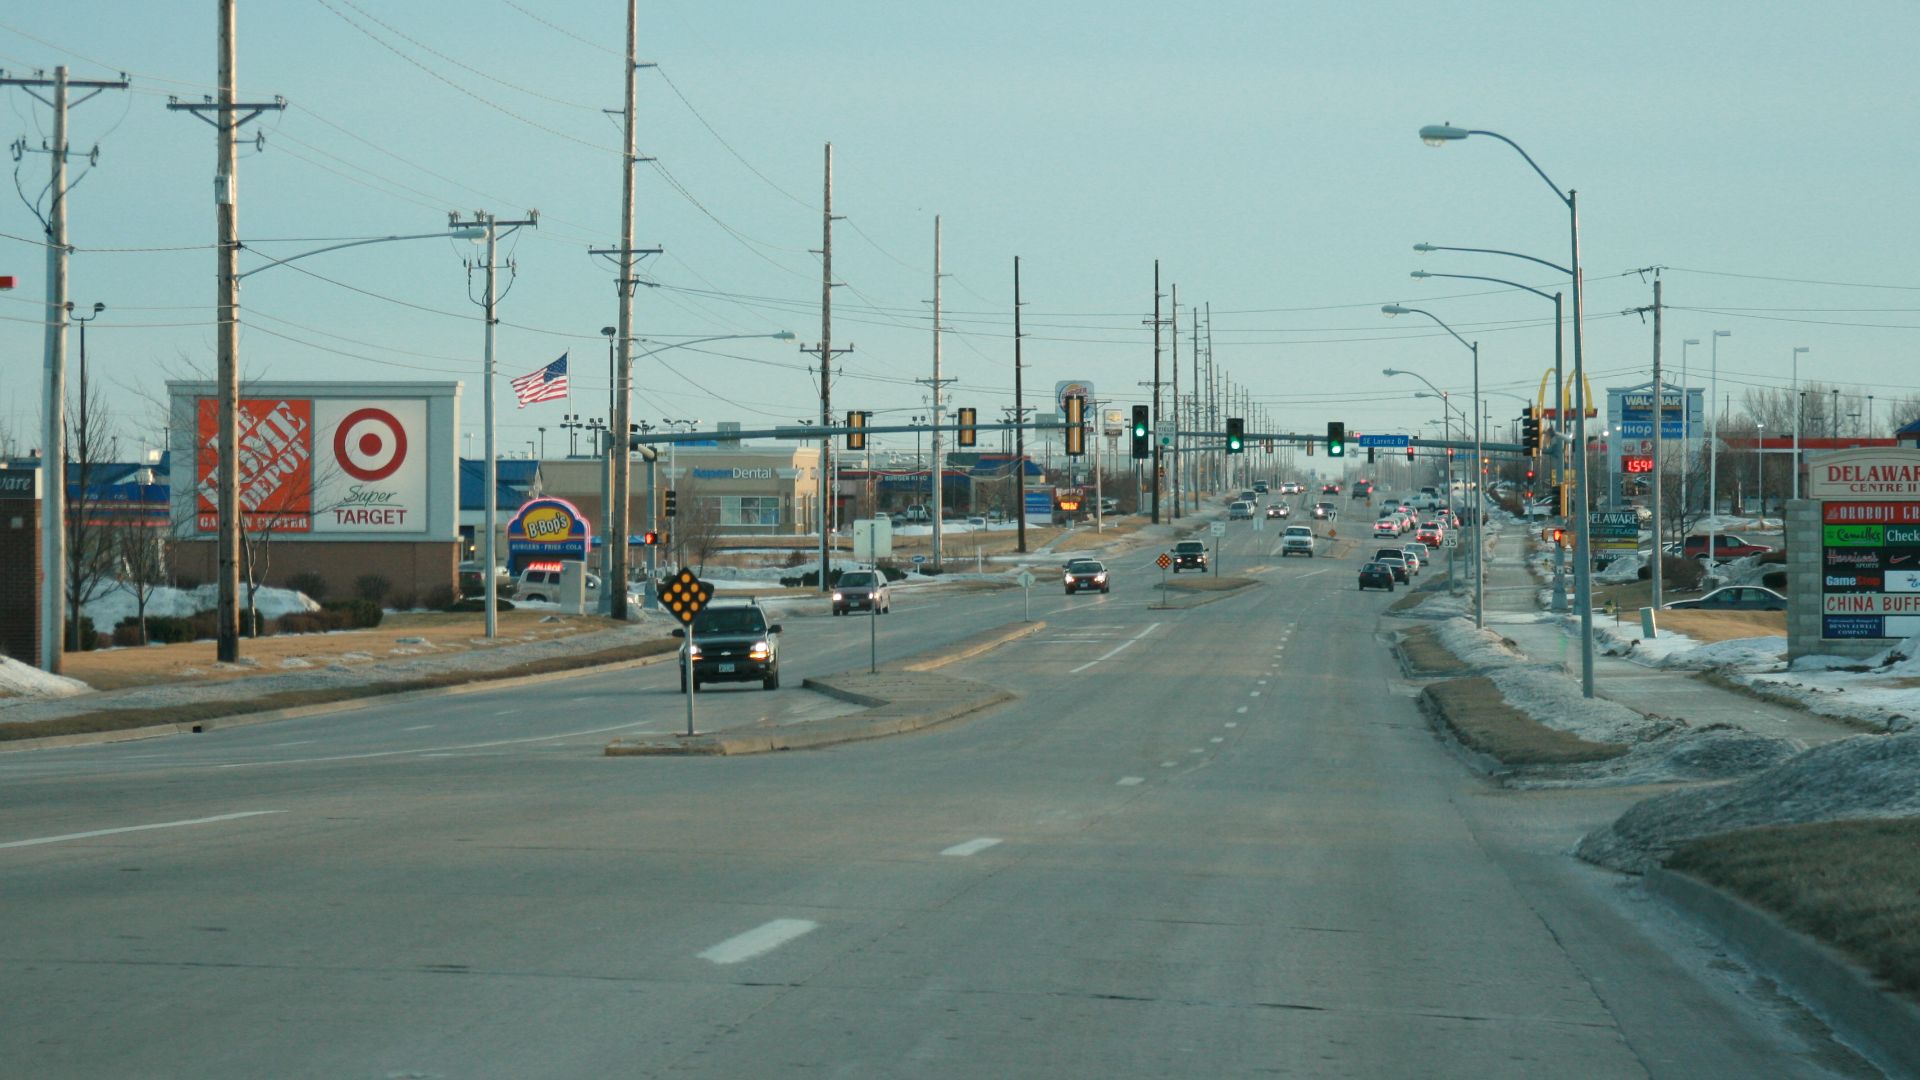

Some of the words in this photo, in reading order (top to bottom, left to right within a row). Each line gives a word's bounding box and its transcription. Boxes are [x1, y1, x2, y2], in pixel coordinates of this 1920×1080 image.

[198, 401, 307, 511] HOME
[239, 438, 310, 512] DEPOT
[732, 467, 772, 479] Dental
[1850, 483, 1903, 492] CENTRE
[343, 485, 398, 508] Super
[256, 515, 307, 529] CENTER
[334, 509, 407, 525] TARGET
[1444, 538, 1457, 546] 35
[1887, 529, 1920, 542] Check
[1826, 596, 1874, 612] CHINA
[1882, 596, 1920, 611] BUFF
